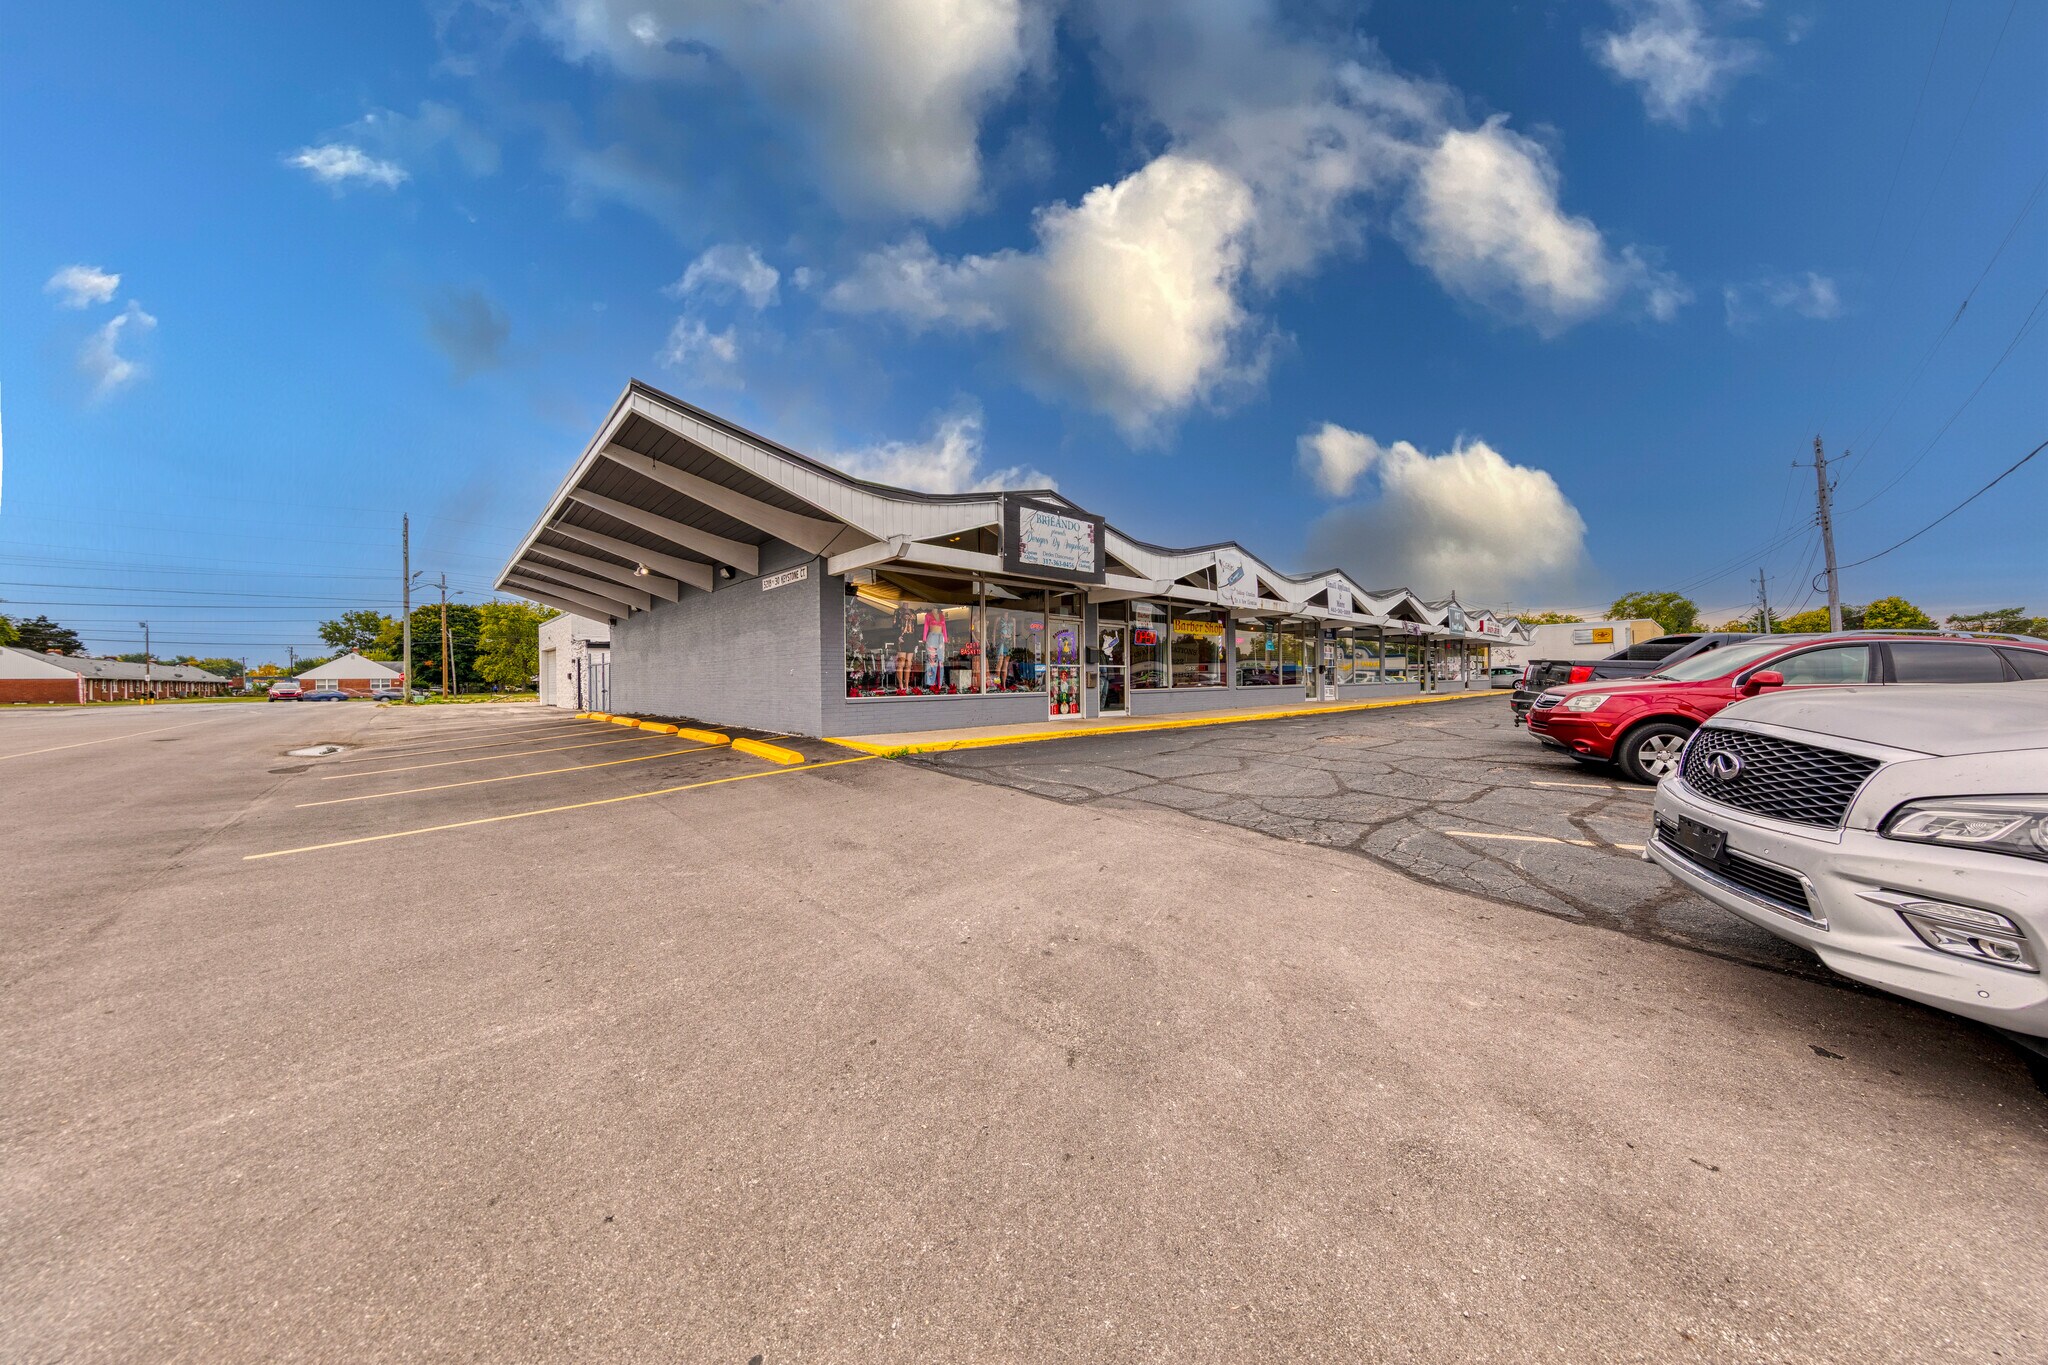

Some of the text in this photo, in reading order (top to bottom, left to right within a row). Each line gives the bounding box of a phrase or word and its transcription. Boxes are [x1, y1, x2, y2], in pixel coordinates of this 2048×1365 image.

[1175, 620, 1223, 635] Barber Shop
[1135, 630, 1156, 644] OPEN
